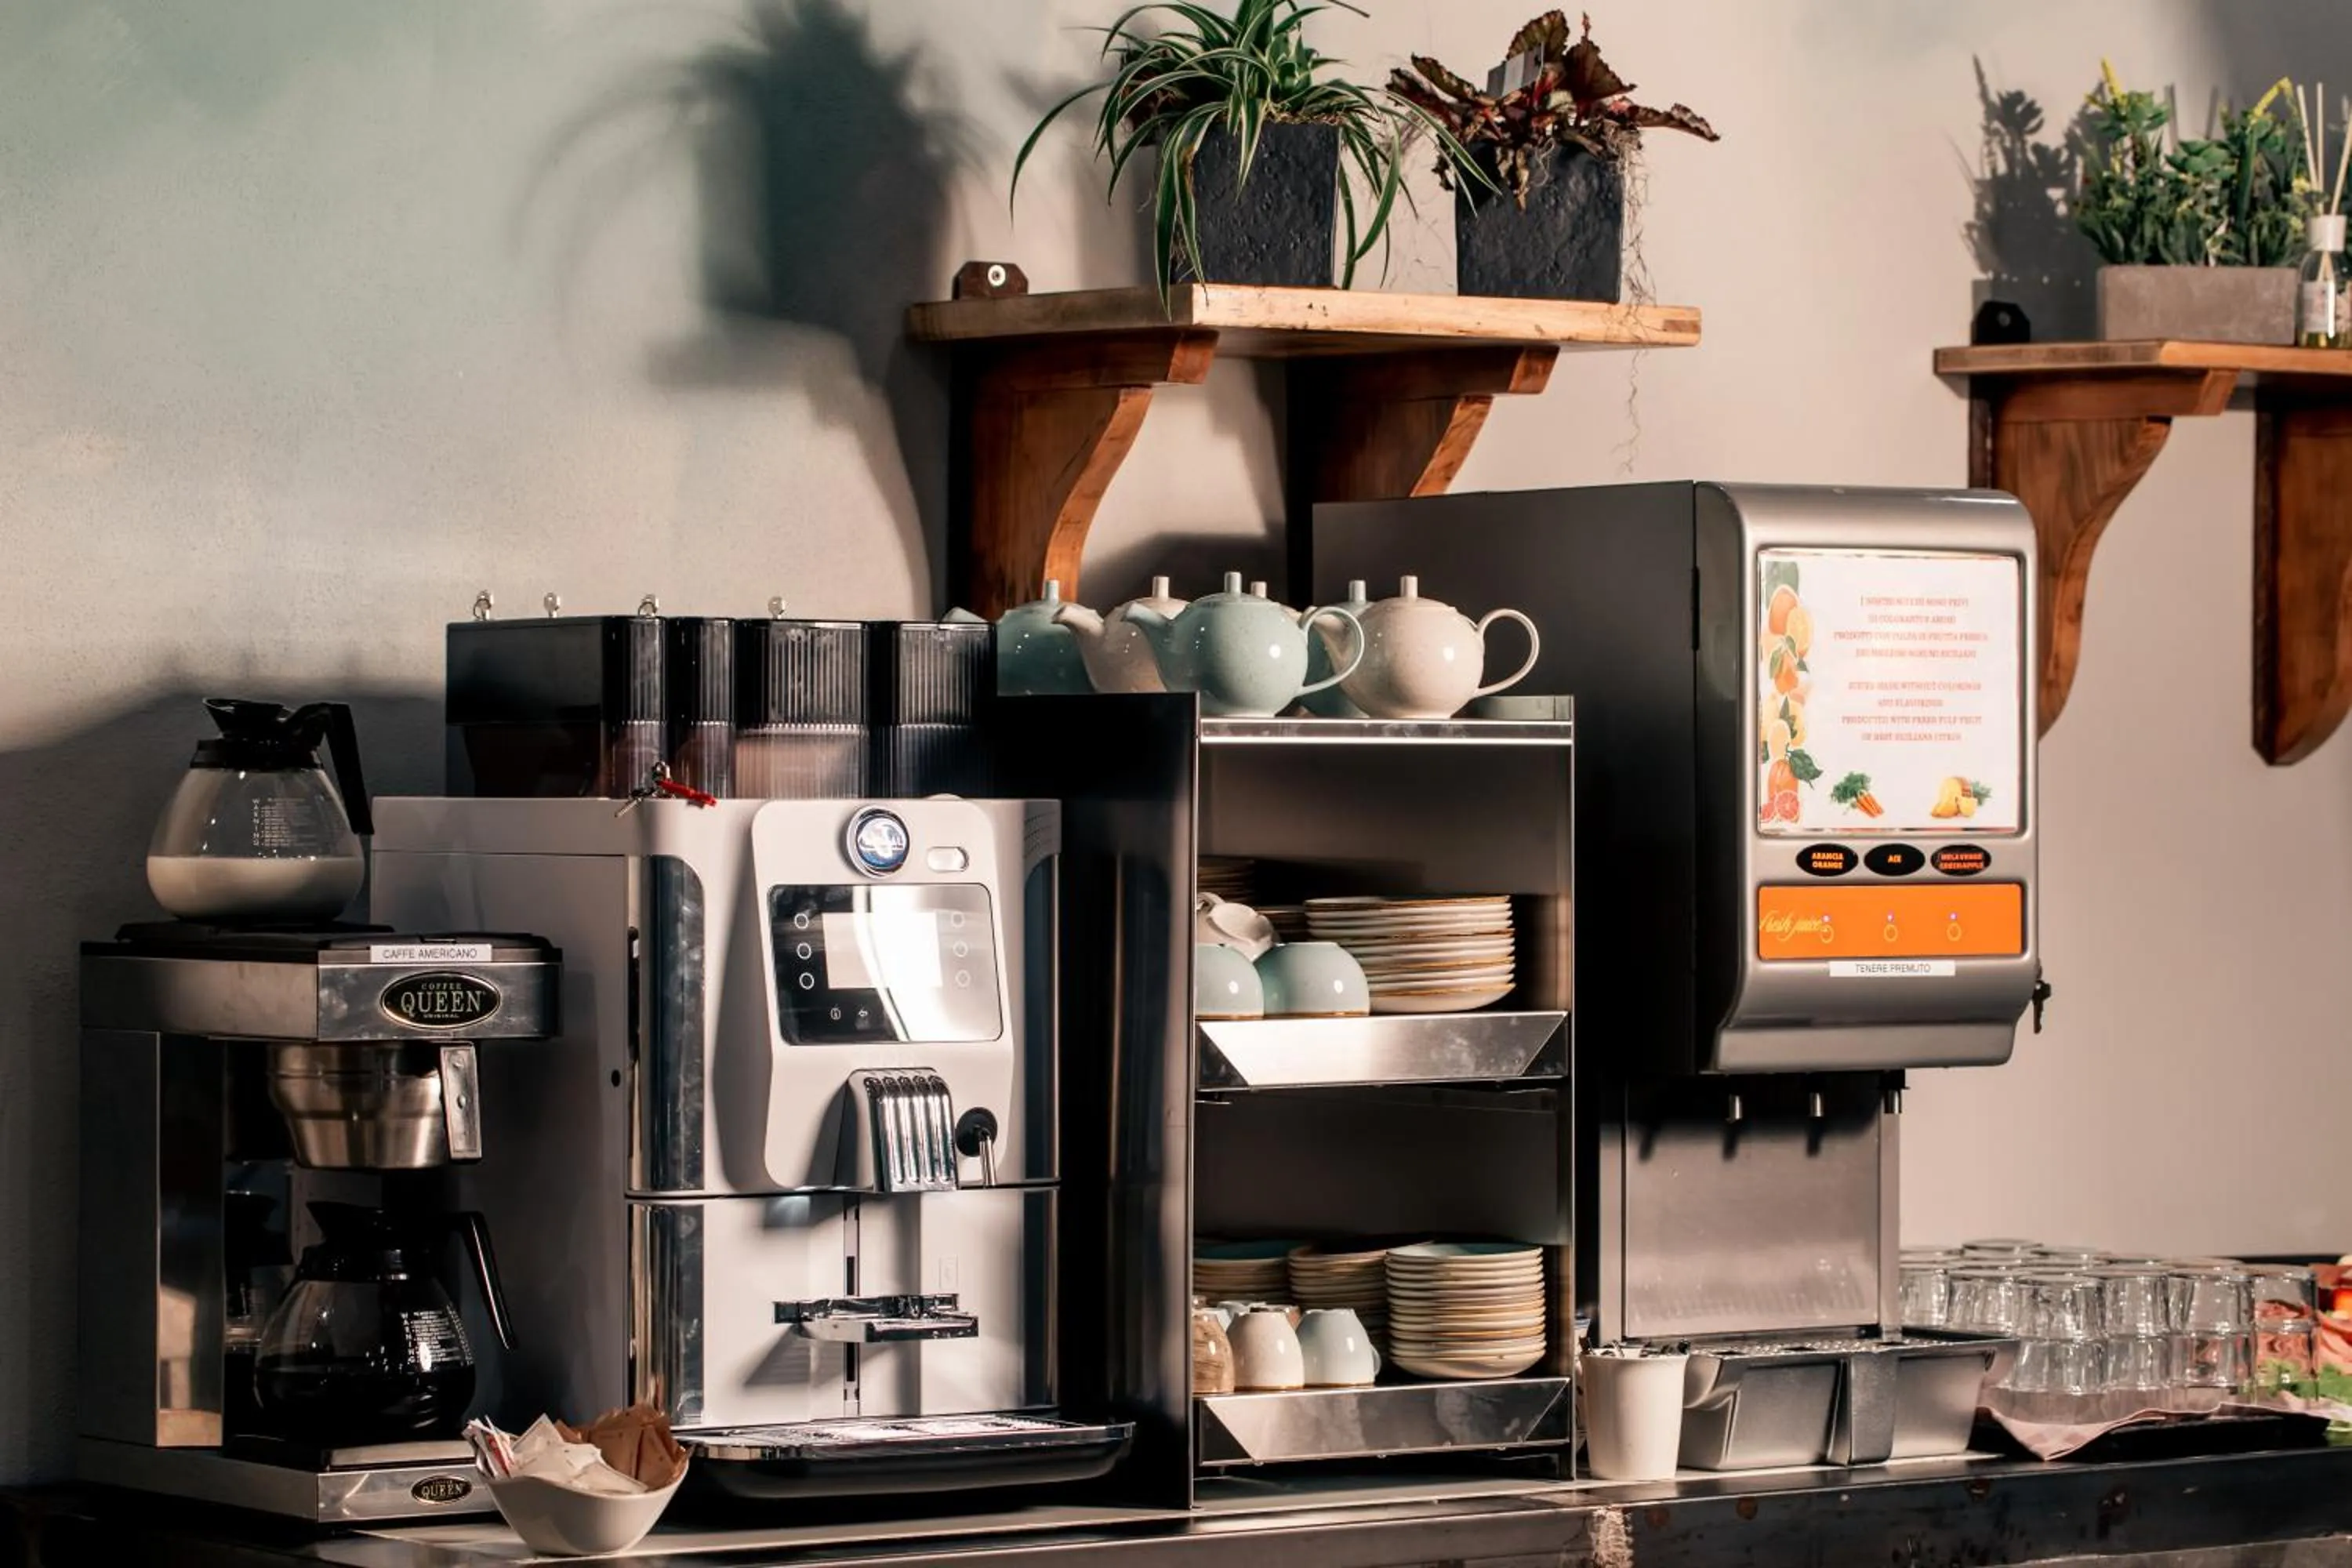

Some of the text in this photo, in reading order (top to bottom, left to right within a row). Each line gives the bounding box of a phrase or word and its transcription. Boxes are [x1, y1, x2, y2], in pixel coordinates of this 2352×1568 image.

[419, 948, 477, 959] AMERICANO
[1856, 963, 1931, 973] TENERE PREMUTO
[401, 990, 482, 1018] QUEEN
[422, 1483, 464, 1500] QUEEN
